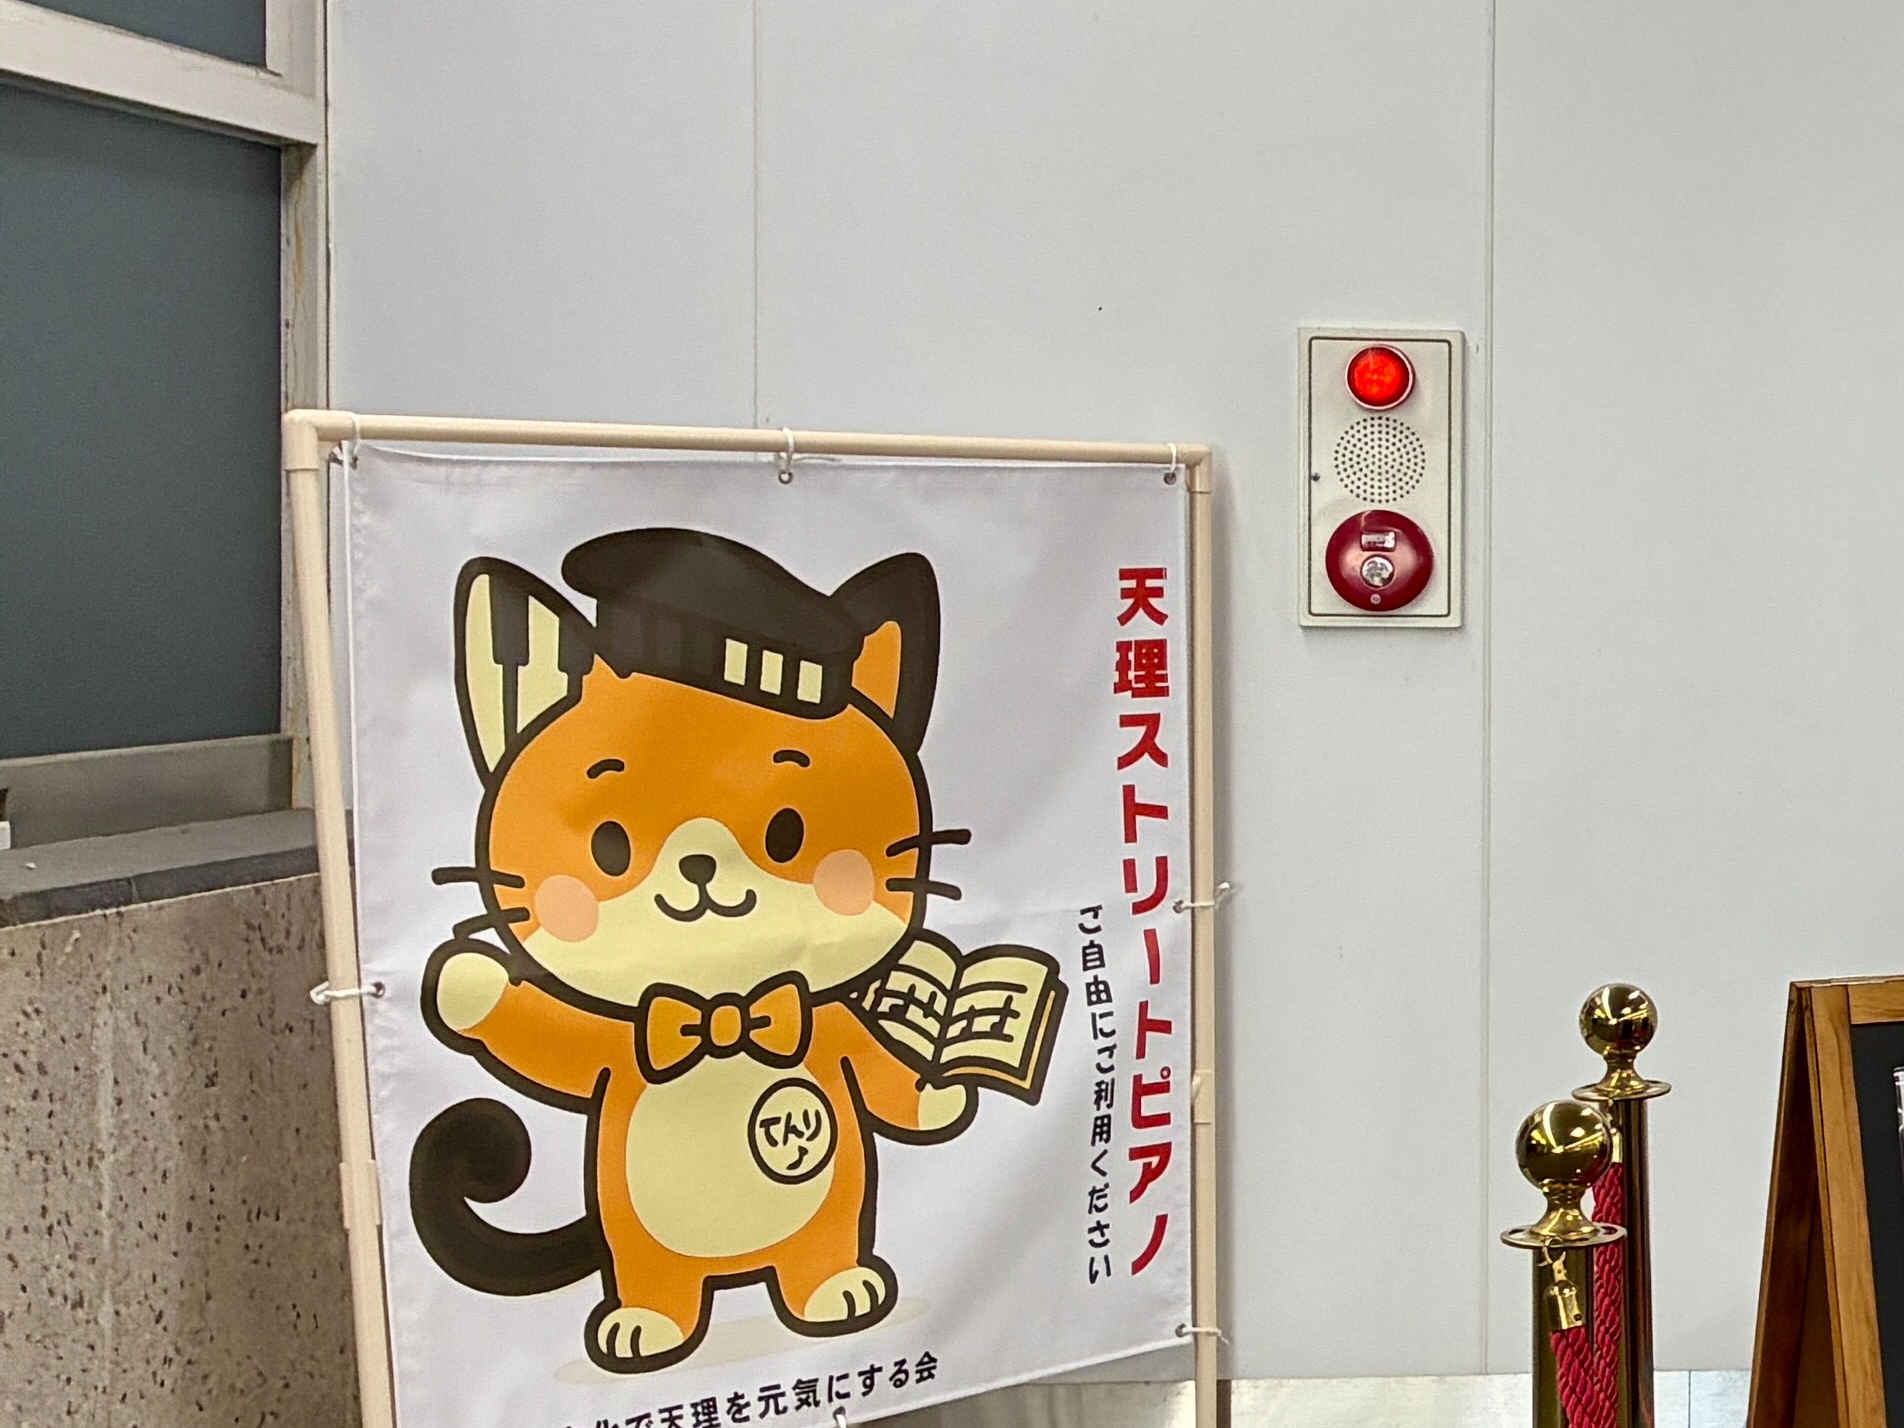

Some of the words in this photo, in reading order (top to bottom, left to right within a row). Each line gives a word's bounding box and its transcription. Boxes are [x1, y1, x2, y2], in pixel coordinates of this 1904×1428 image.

[1077, 905, 1113, 1285] ご自由にご利用ください
[1112, 566, 1176, 1276] 天理ストリートピアノ
[758, 1109, 824, 1149] てんり
